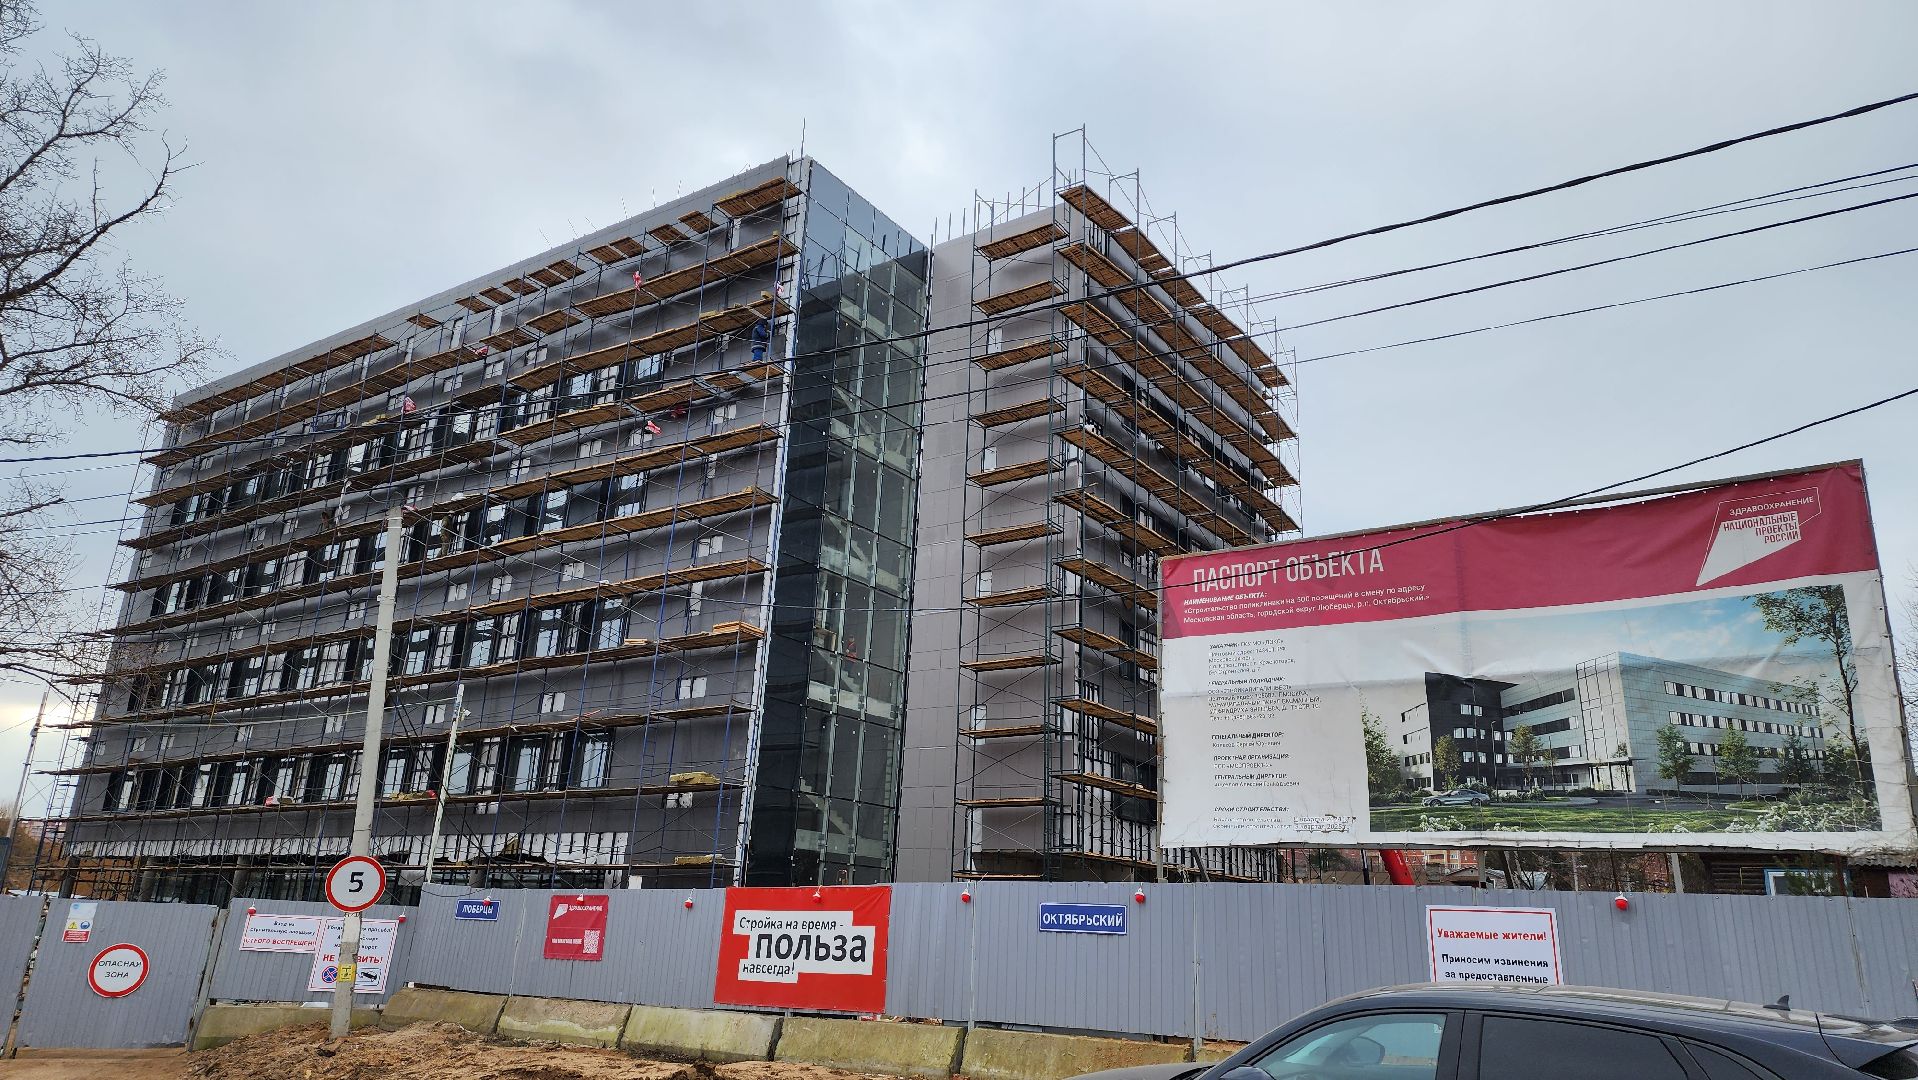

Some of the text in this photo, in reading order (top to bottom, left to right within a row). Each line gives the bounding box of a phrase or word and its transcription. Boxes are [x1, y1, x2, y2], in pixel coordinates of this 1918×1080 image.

[1729, 496, 1814, 516] ЗДРАВООХРАНЕНИЕ
[1723, 512, 1797, 532] НАЦИОНАЛЬНЫЕ
[1755, 522, 1798, 536] ПРОЕКТЫ
[1764, 531, 1799, 544] РОССИИ
[1193, 548, 1384, 592] ПАСПОРТ ОБЪЕКТА
[1361, 589, 1385, 598] смену
[1397, 584, 1426, 594] адресу
[1183, 615, 1225, 623] Московская
[1257, 606, 1294, 617] городской
[1295, 605, 1316, 614] округ
[1317, 602, 1356, 611] Люберцы,
[348, 872, 365, 893] 5
[739, 917, 783, 933] Стройка
[785, 920, 798, 930] на
[801, 920, 837, 933] время
[1042, 912, 1123, 927] ОКТЯБРЬСКИЙ
[1437, 927, 1547, 941] Уважаемые жители!
[755, 933, 867, 962] польза
[323, 954, 335, 962] НЕ
[1441, 953, 1549, 968] Приносим извинения
[743, 962, 795, 977] навсегда!
[1459, 972, 1548, 984] предоставленные
